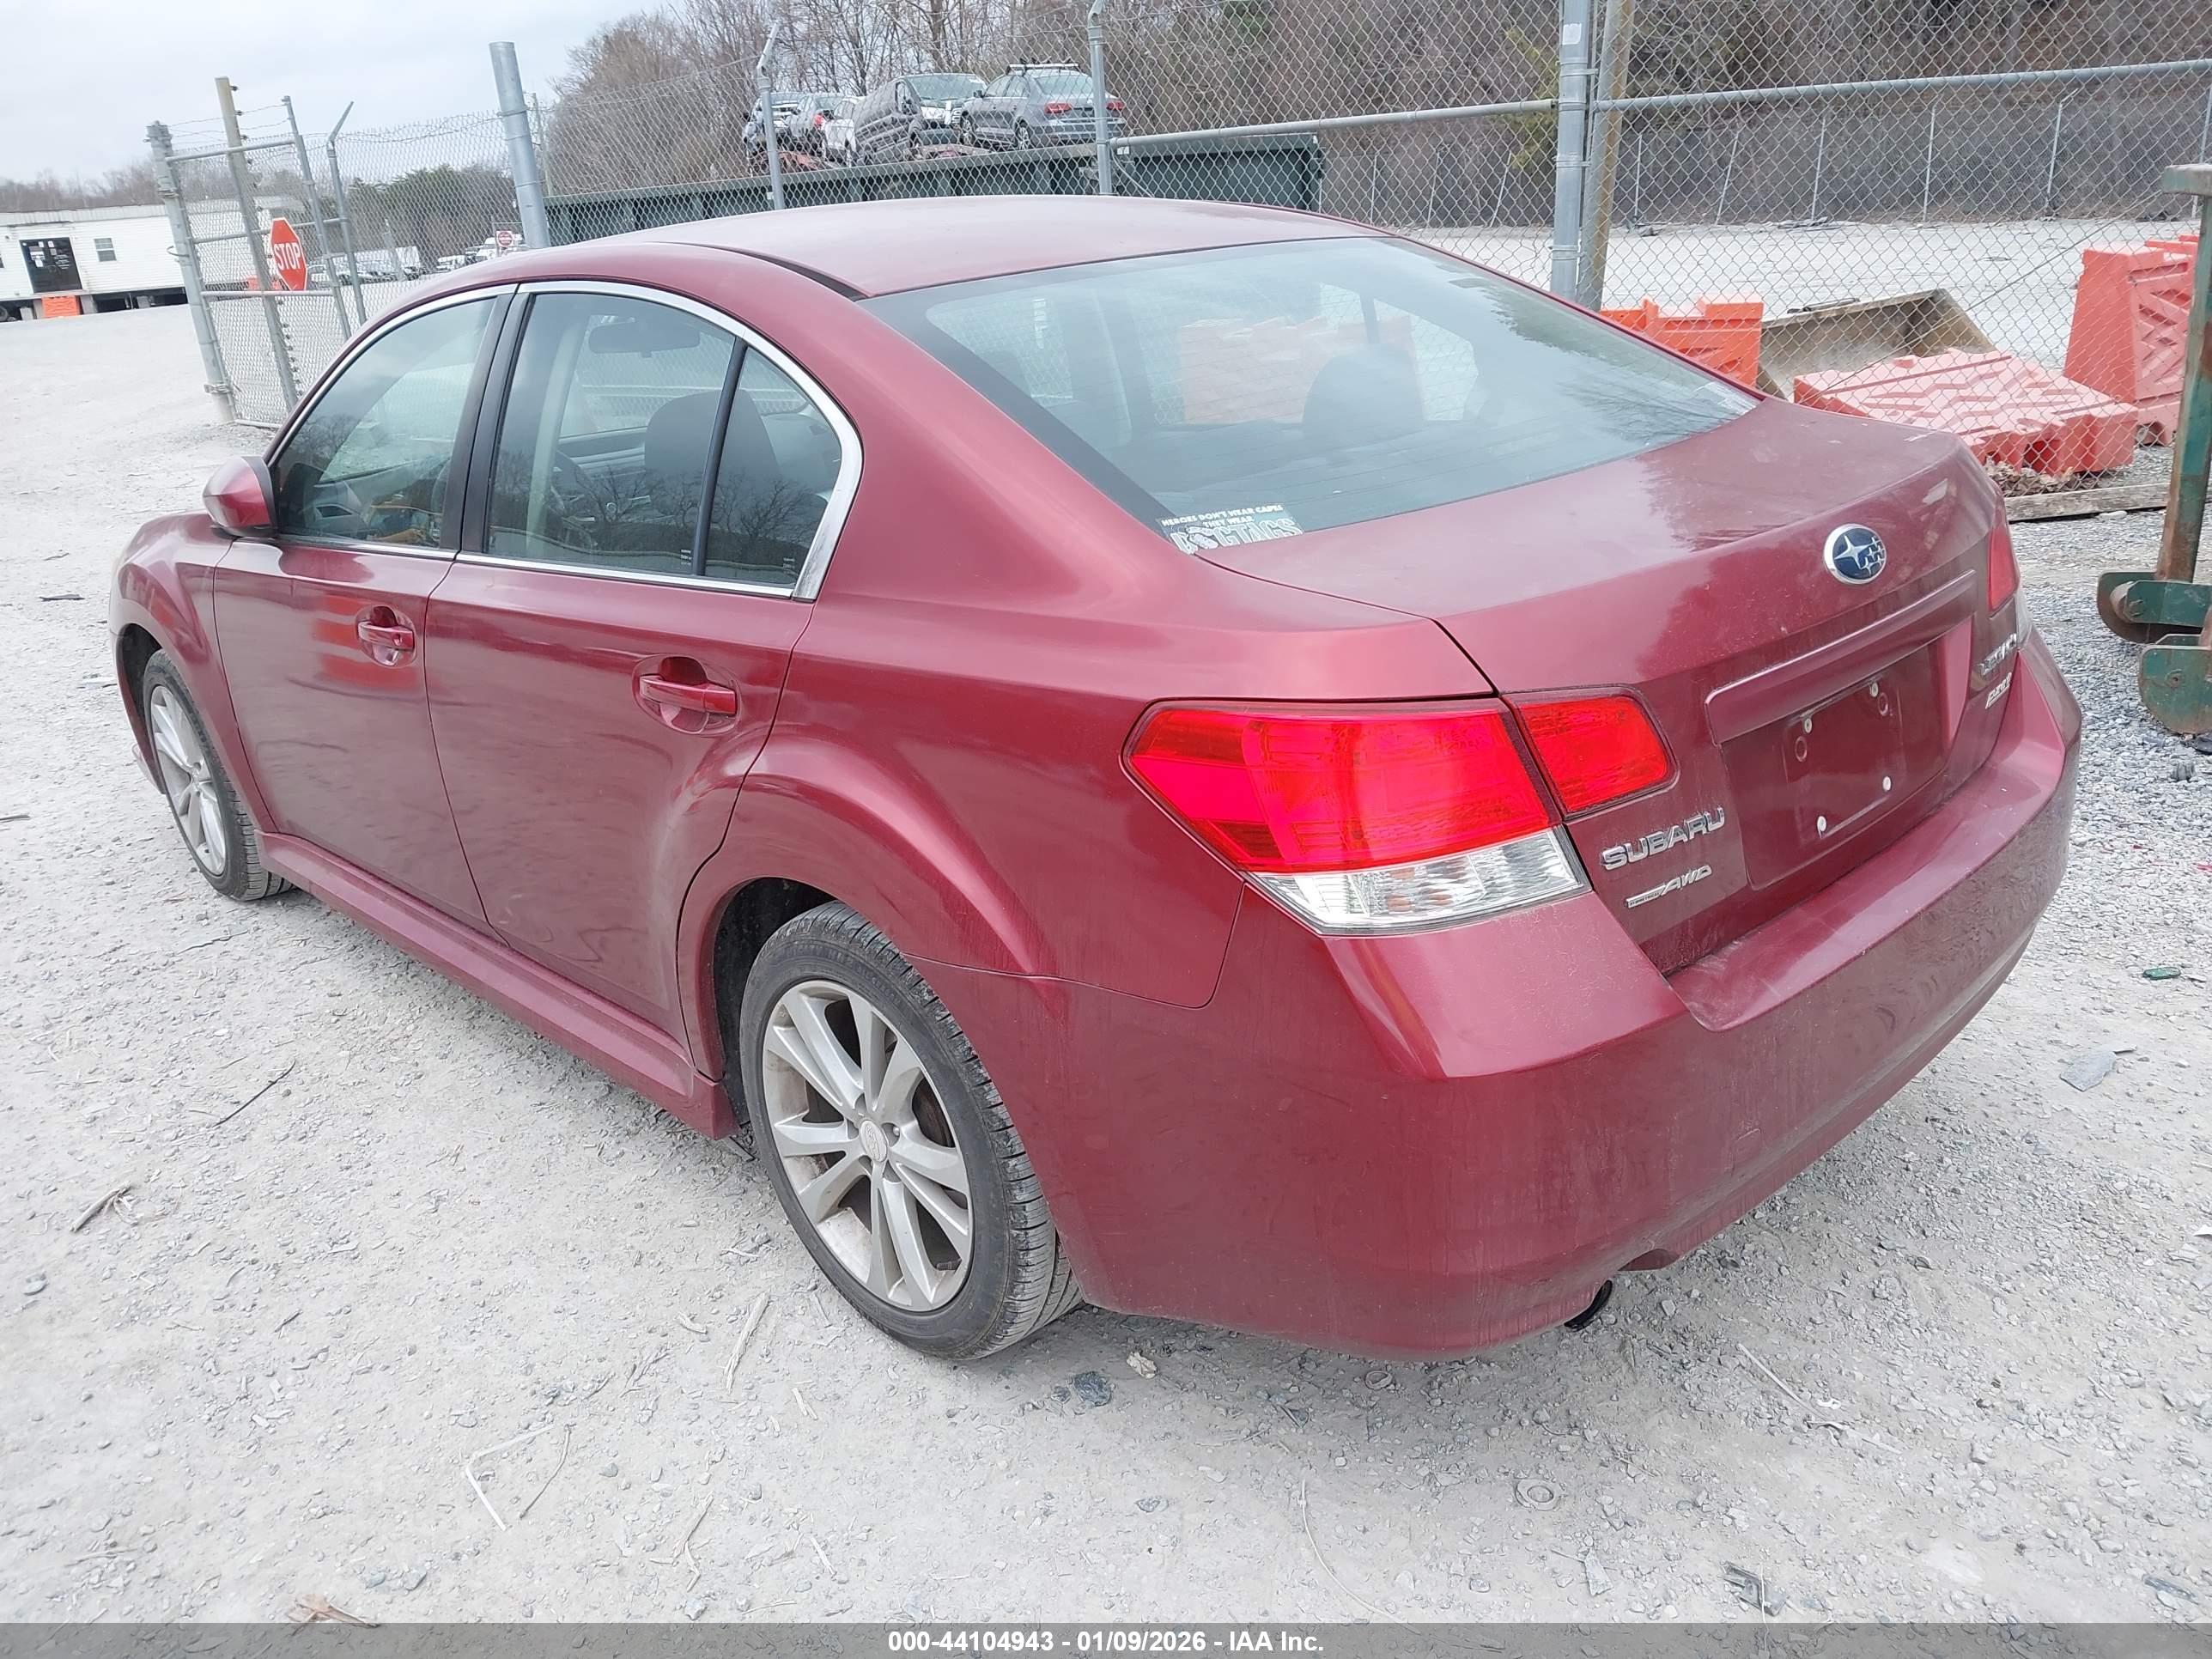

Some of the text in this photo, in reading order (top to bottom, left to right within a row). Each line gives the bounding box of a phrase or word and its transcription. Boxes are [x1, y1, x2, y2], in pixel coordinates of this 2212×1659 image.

[274, 242, 301, 270] STOP
[1161, 504, 1284, 526] HEROES DON'T WEAR CAPES
[1203, 515, 1255, 528] THEY WEAR
[1601, 807, 1725, 871] SUBARU
[1662, 865, 1712, 896] AWD
